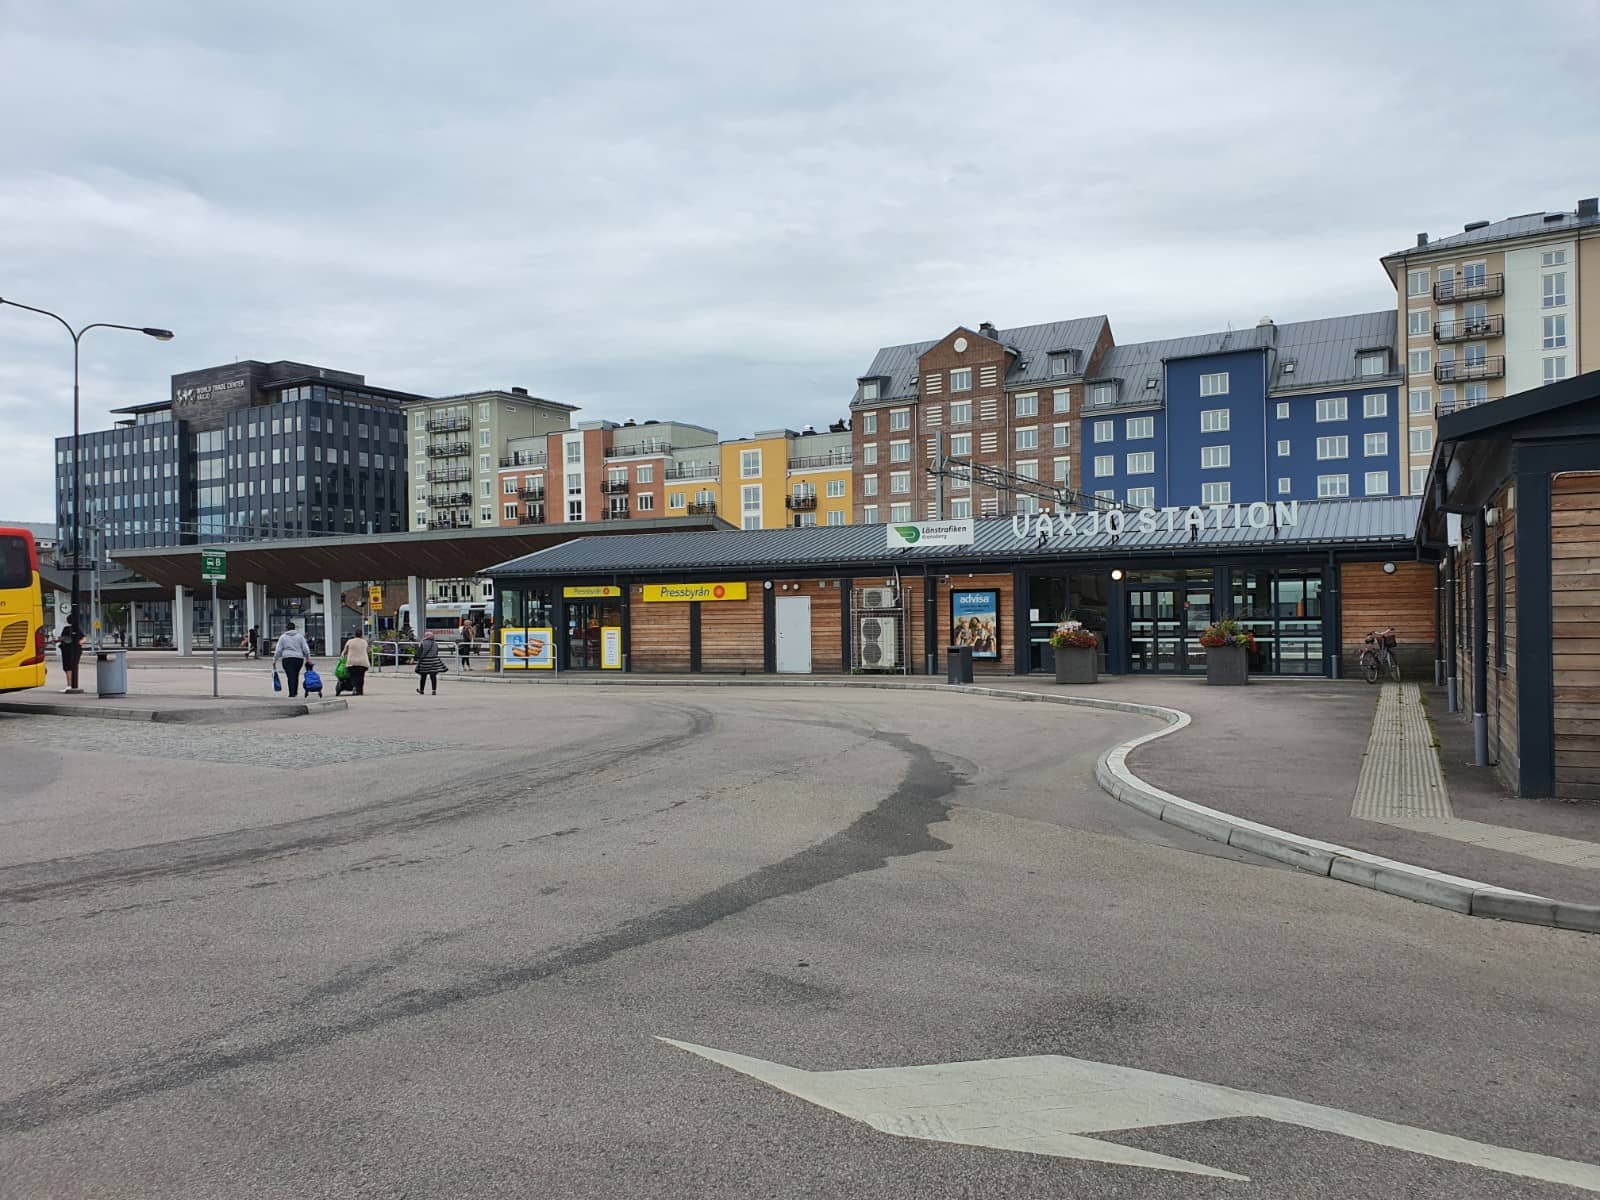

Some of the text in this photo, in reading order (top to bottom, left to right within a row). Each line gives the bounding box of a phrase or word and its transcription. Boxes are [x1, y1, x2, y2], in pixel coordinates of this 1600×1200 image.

[212, 383, 226, 392] TRADE
[226, 380, 244, 389] CENTER
[1012, 500, 1298, 539] VÄXJÖ STATION
[921, 525, 967, 534] Länstrafiken
[660, 586, 710, 600] Pressbyrån
[959, 593, 990, 604] advisa
